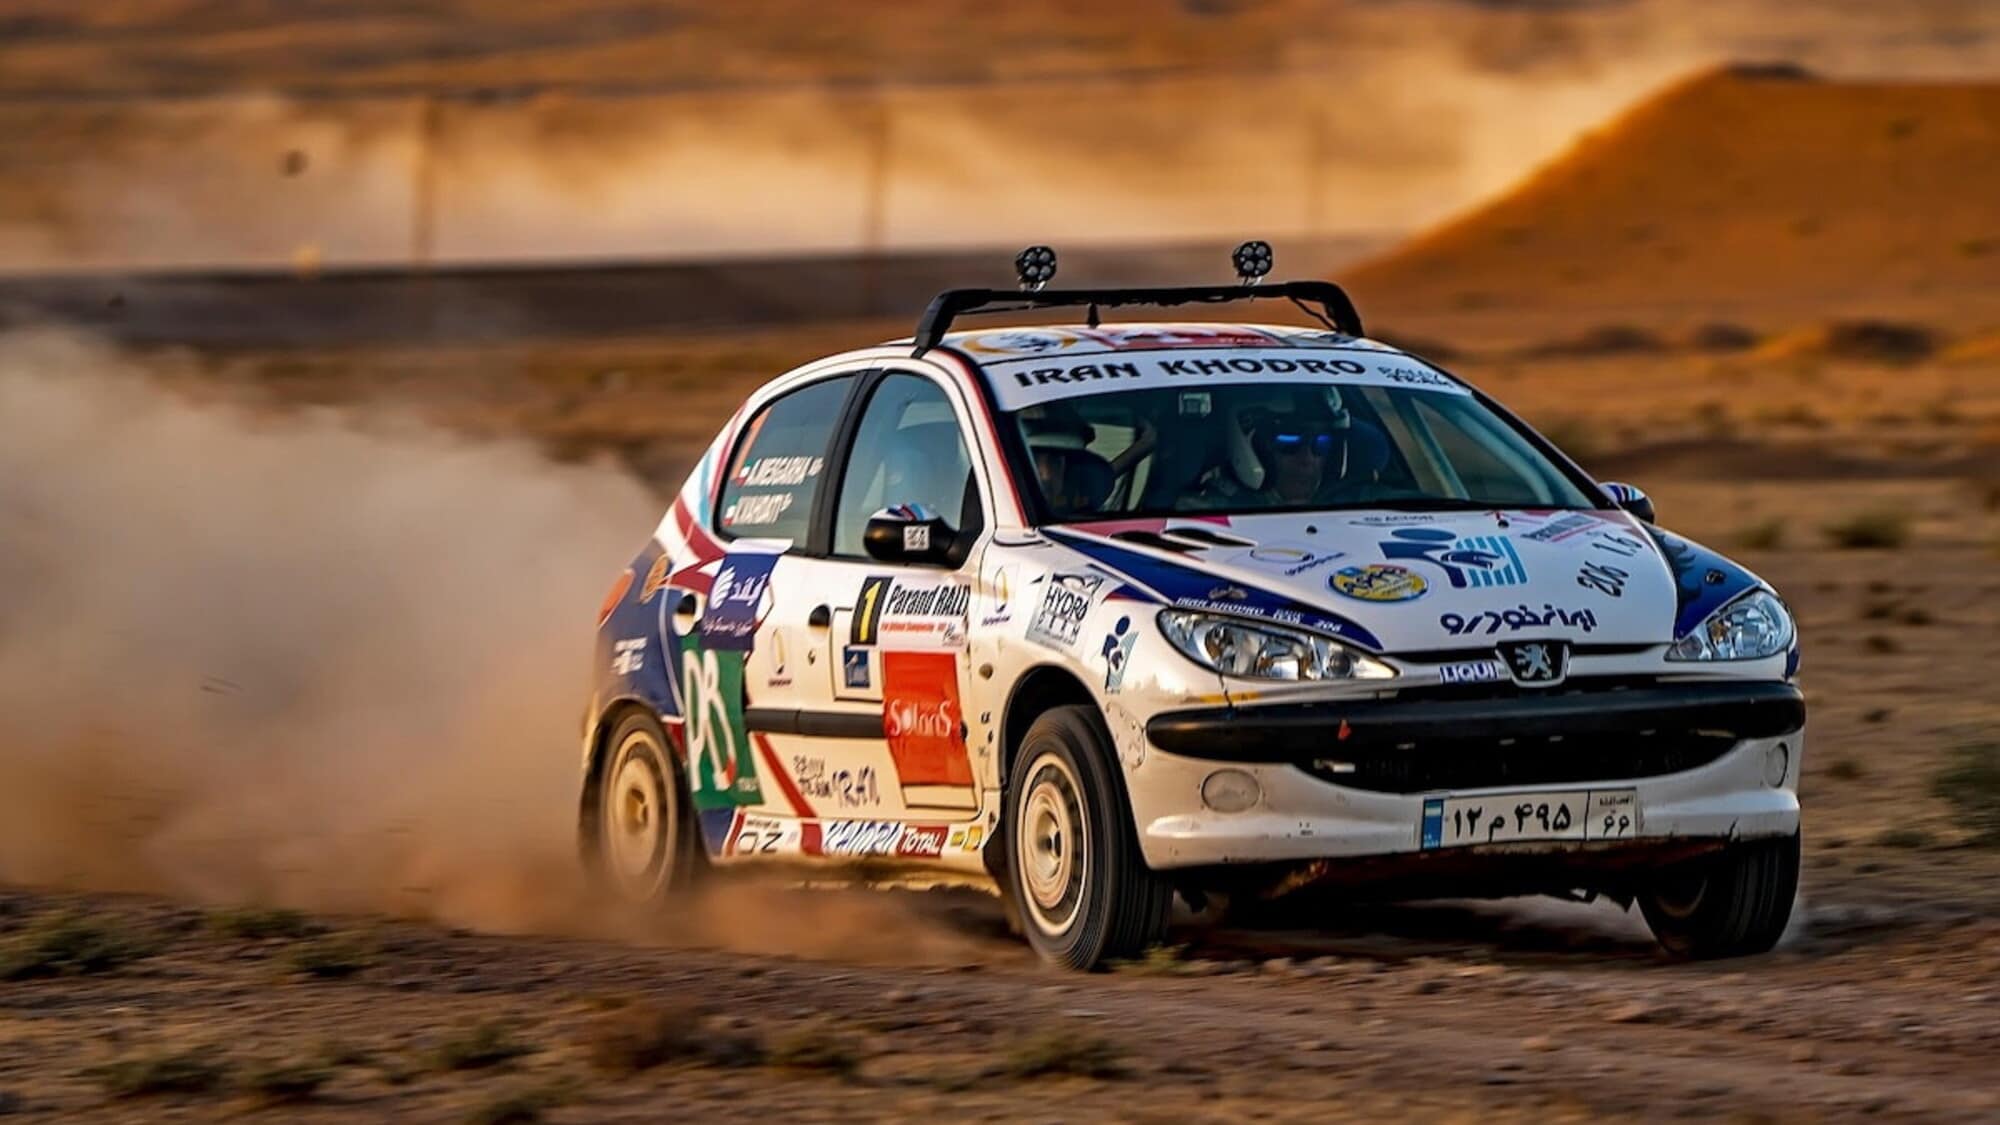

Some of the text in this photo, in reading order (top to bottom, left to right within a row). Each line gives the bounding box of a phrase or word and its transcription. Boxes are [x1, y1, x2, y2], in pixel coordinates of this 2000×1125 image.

[1014, 358, 1366, 387] IRAN KHODRO
[1577, 533, 1643, 597] 206 1.6
[859, 580, 882, 642] 1
[884, 584, 940, 615] Parand
[1043, 584, 1089, 621] HYDRO
[1443, 663, 1497, 683] LIQUI
[900, 828, 942, 854] TOTAL
